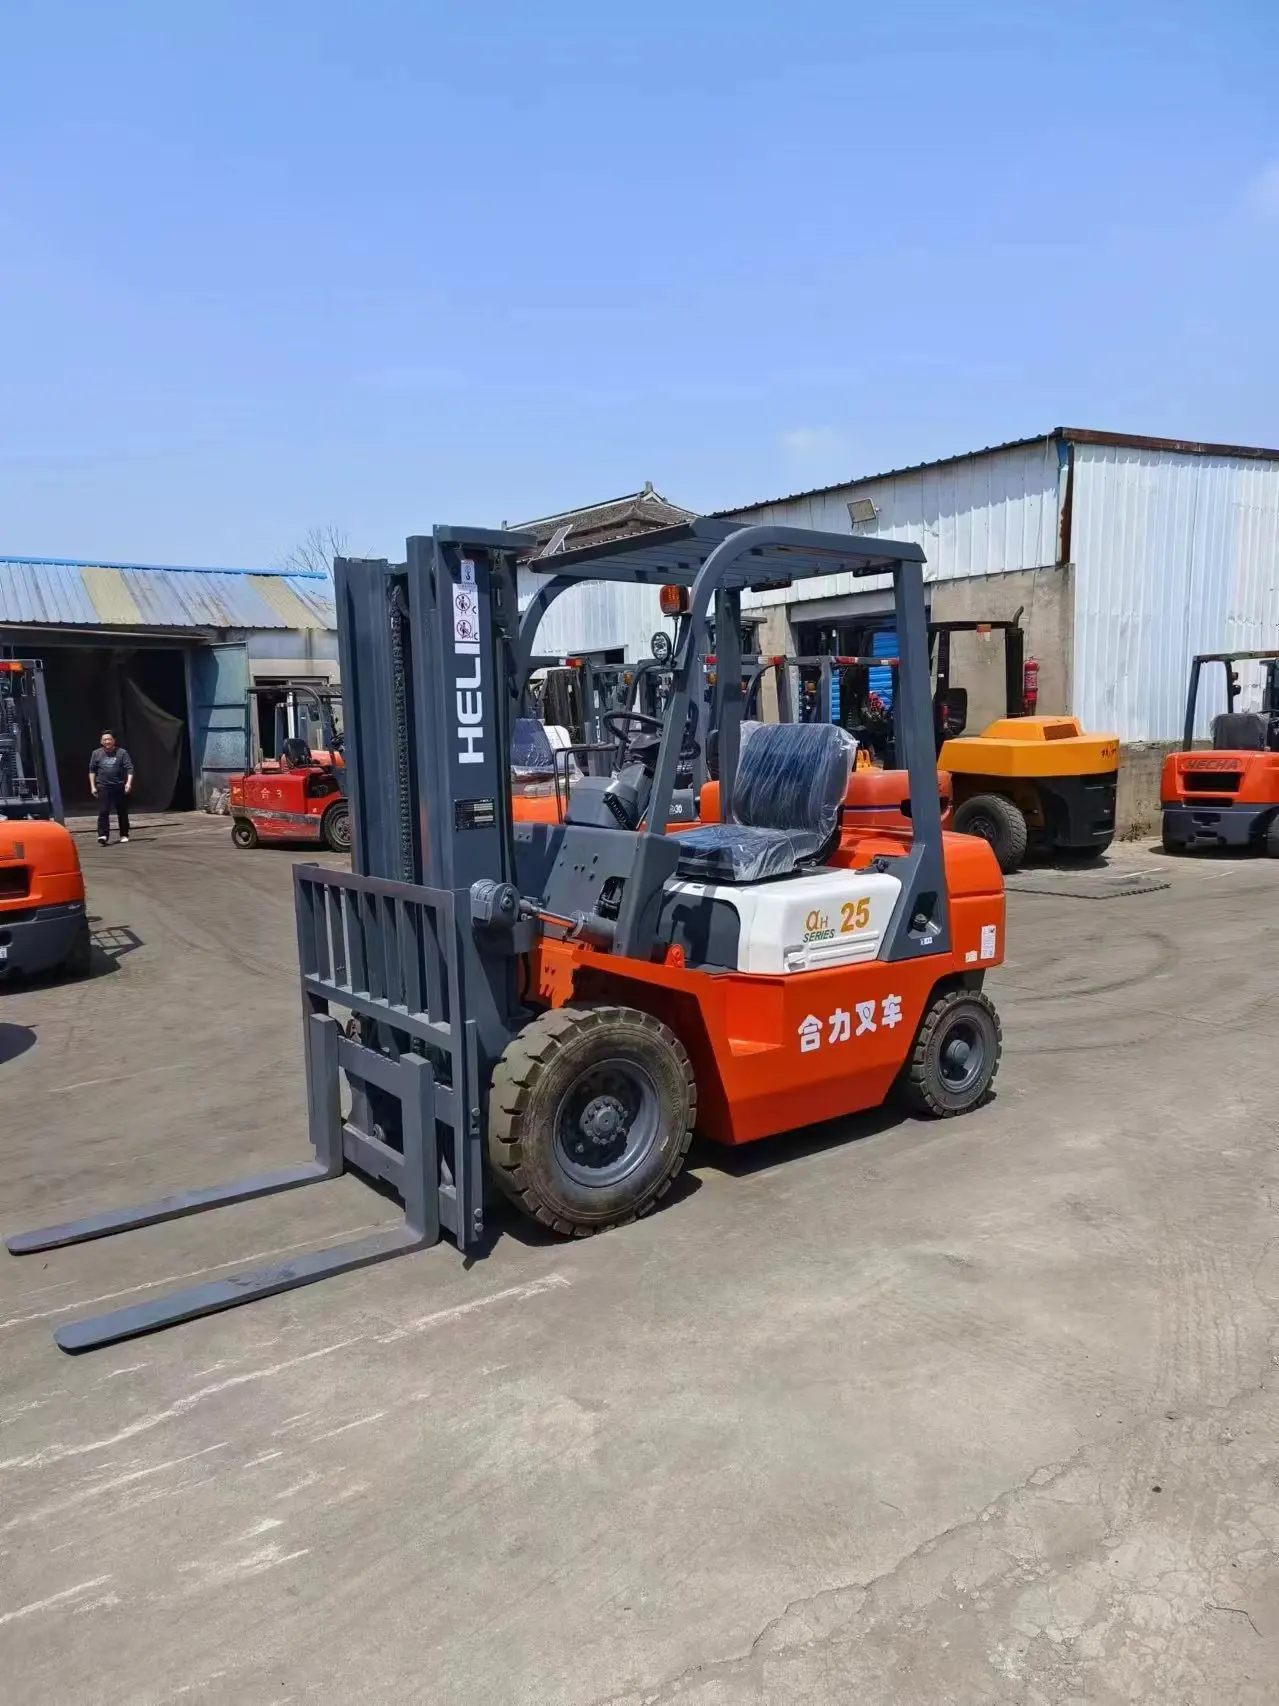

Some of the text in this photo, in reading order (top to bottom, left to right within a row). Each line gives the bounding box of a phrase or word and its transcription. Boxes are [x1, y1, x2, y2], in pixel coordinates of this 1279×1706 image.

[454, 642, 484, 764] HELI
[803, 928, 835, 943] SERIES
[840, 896, 871, 933] 25
[798, 993, 903, 1053] 合力叉车
